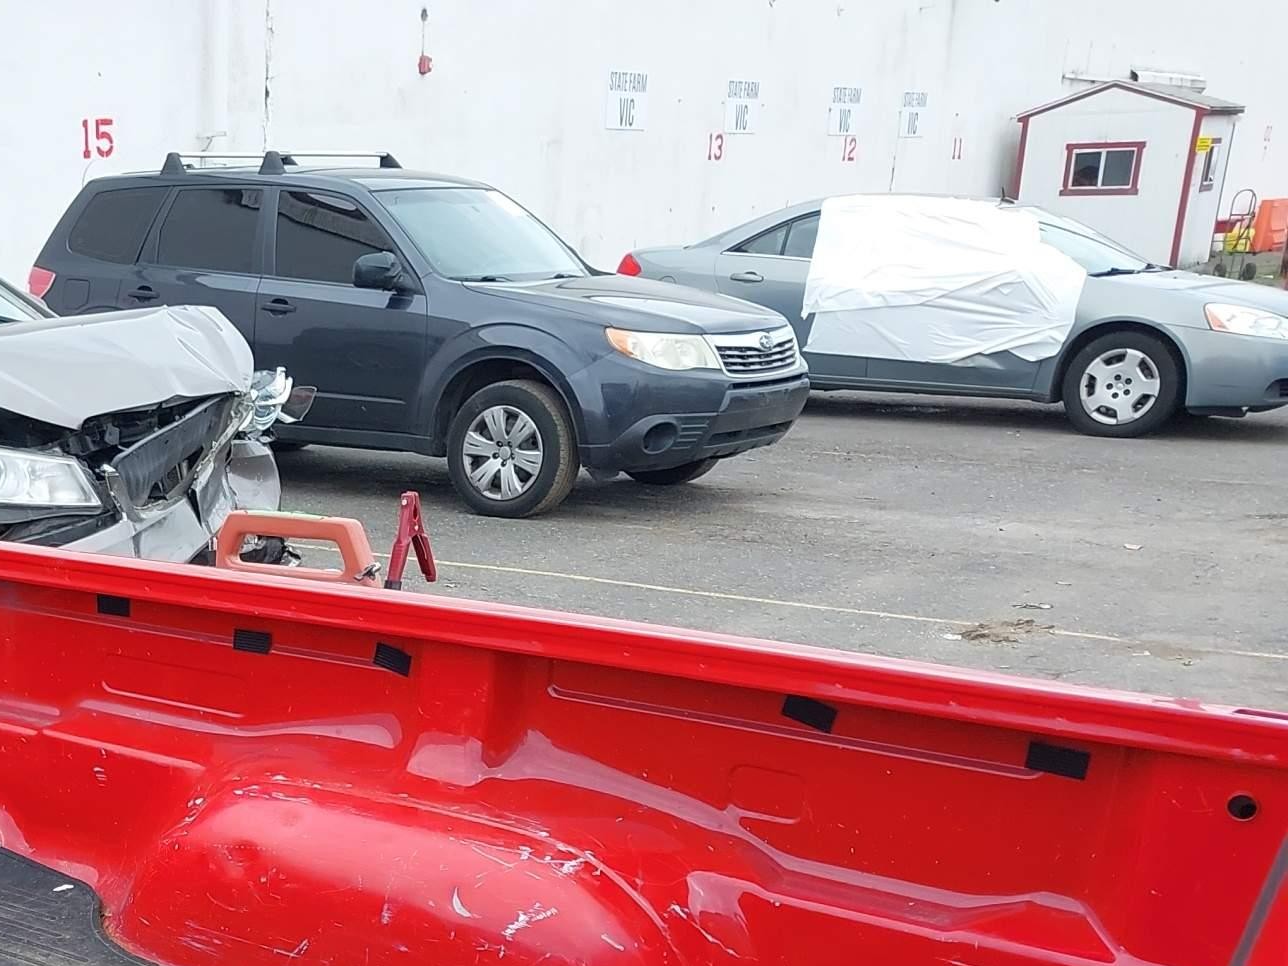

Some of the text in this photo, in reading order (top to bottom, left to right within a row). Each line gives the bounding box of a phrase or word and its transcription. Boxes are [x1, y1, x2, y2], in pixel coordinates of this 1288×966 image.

[609, 71, 648, 93] STATE FARM
[728, 80, 760, 99] STATE FARM
[832, 87, 862, 104] STATE FARM
[619, 97, 635, 127] VIC
[735, 104, 749, 131] VIC
[839, 108, 852, 133] VIC
[82, 118, 114, 159] 15
[707, 133, 724, 161] 13
[841, 136, 857, 162] 12
[951, 137, 963, 160] 11
